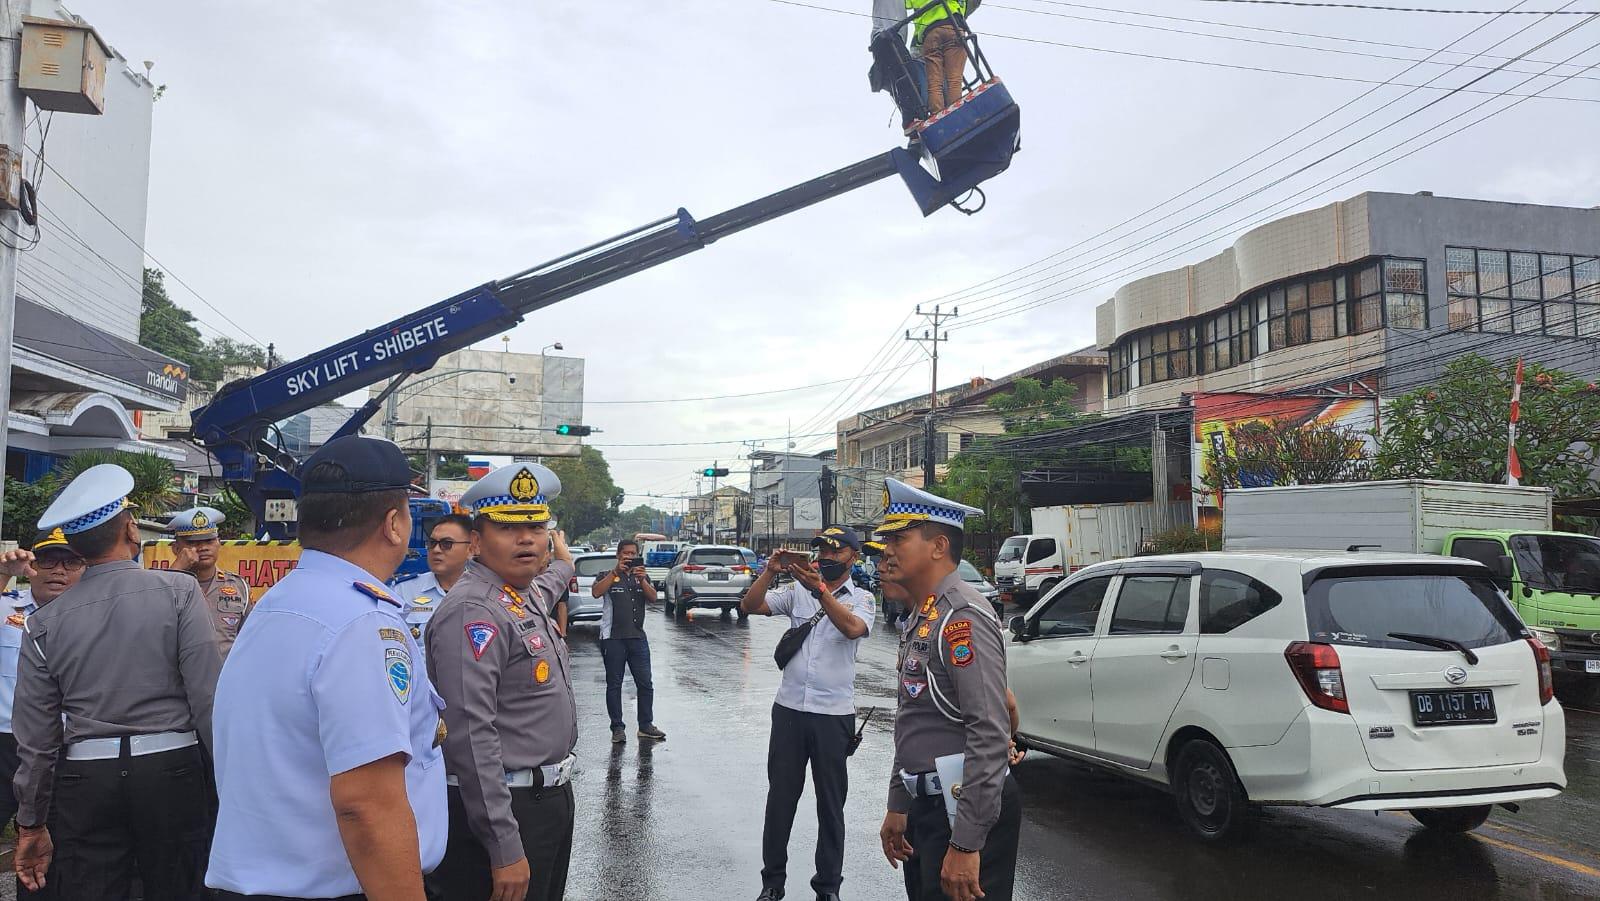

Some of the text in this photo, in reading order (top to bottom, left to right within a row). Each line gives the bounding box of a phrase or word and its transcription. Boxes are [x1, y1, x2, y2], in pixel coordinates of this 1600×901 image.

[147, 371, 178, 393] mandiri
[286, 367, 320, 396] SKY
[324, 351, 359, 382] LIFT
[1417, 692, 1491, 713] DB 1157 FM
